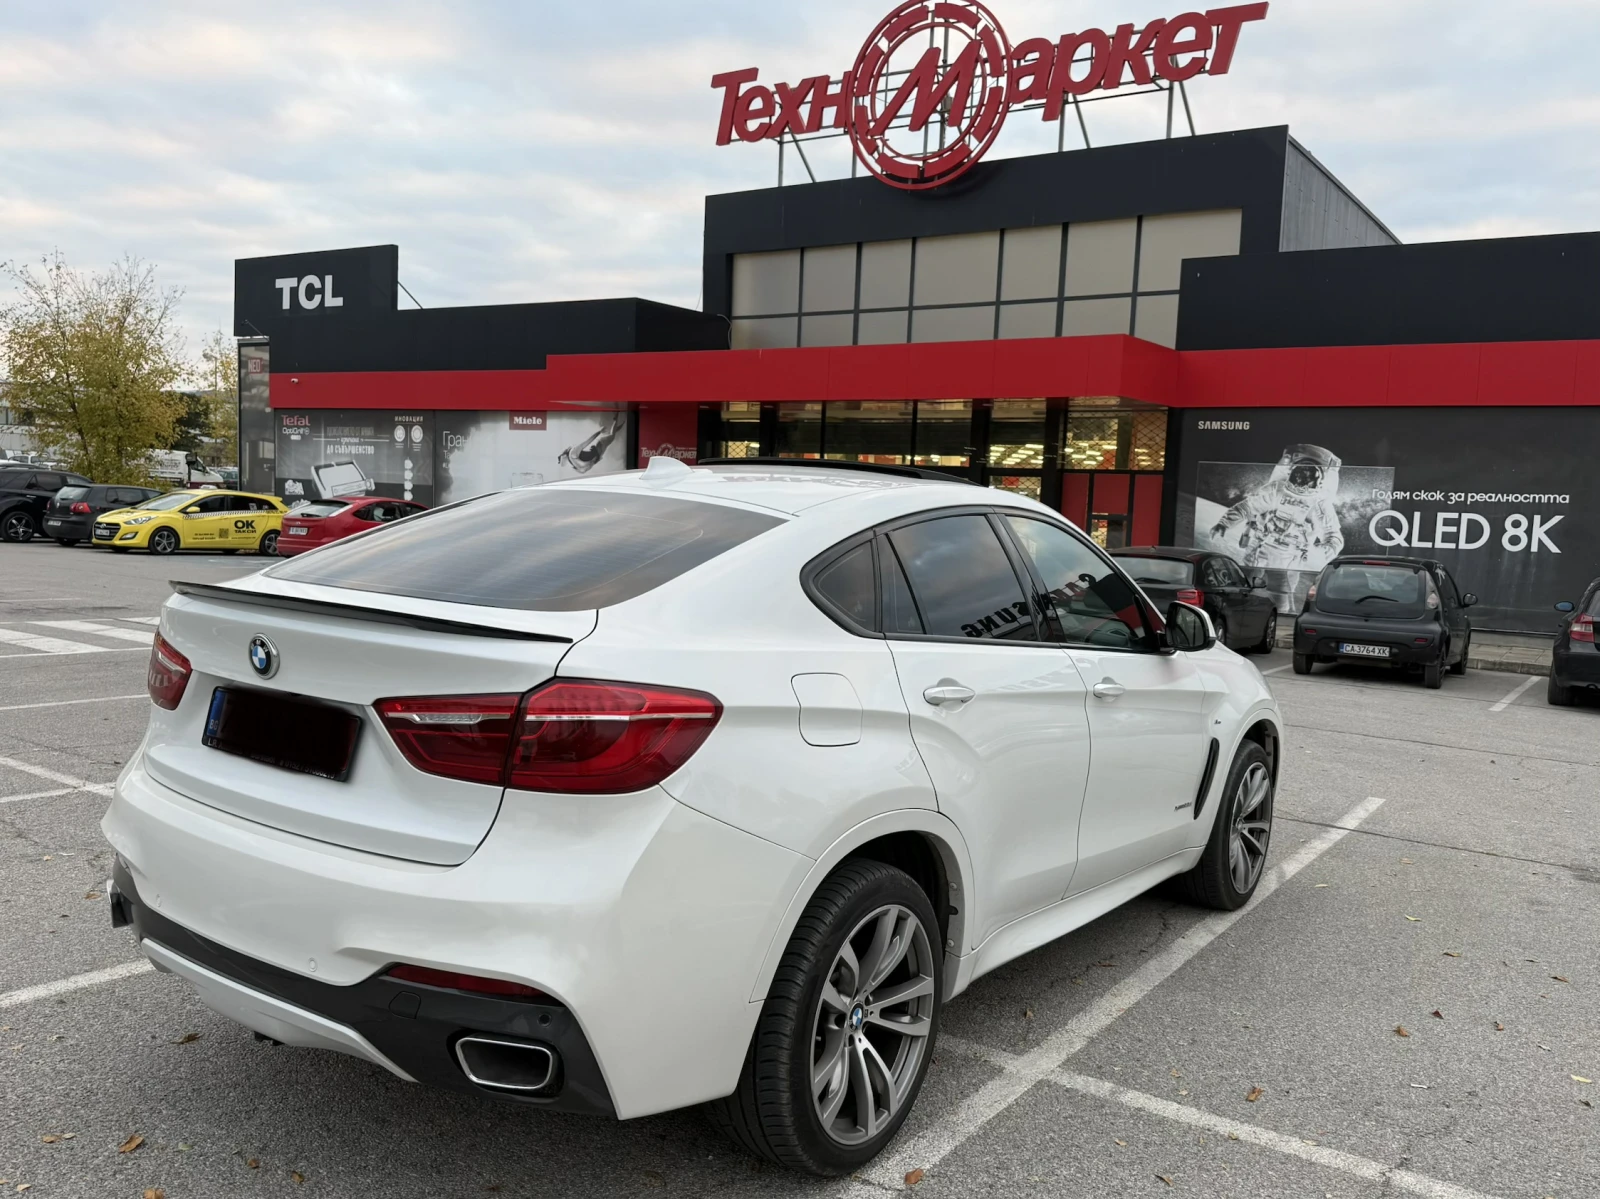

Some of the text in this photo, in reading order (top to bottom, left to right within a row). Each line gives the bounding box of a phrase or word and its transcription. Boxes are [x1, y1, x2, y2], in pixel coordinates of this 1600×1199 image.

[275, 274, 343, 310] TCL
[281, 414, 310, 426] Tefal
[513, 416, 543, 425] Miele
[1197, 420, 1250, 431] SAMSUNG
[1372, 489, 1410, 500] Голям
[1447, 492, 1465, 504] за
[1467, 492, 1570, 505] реалността
[1368, 509, 1566, 554] QLED 8K
[1356, 645, 1376, 654] 3764
[209, 719, 218, 731] BG
